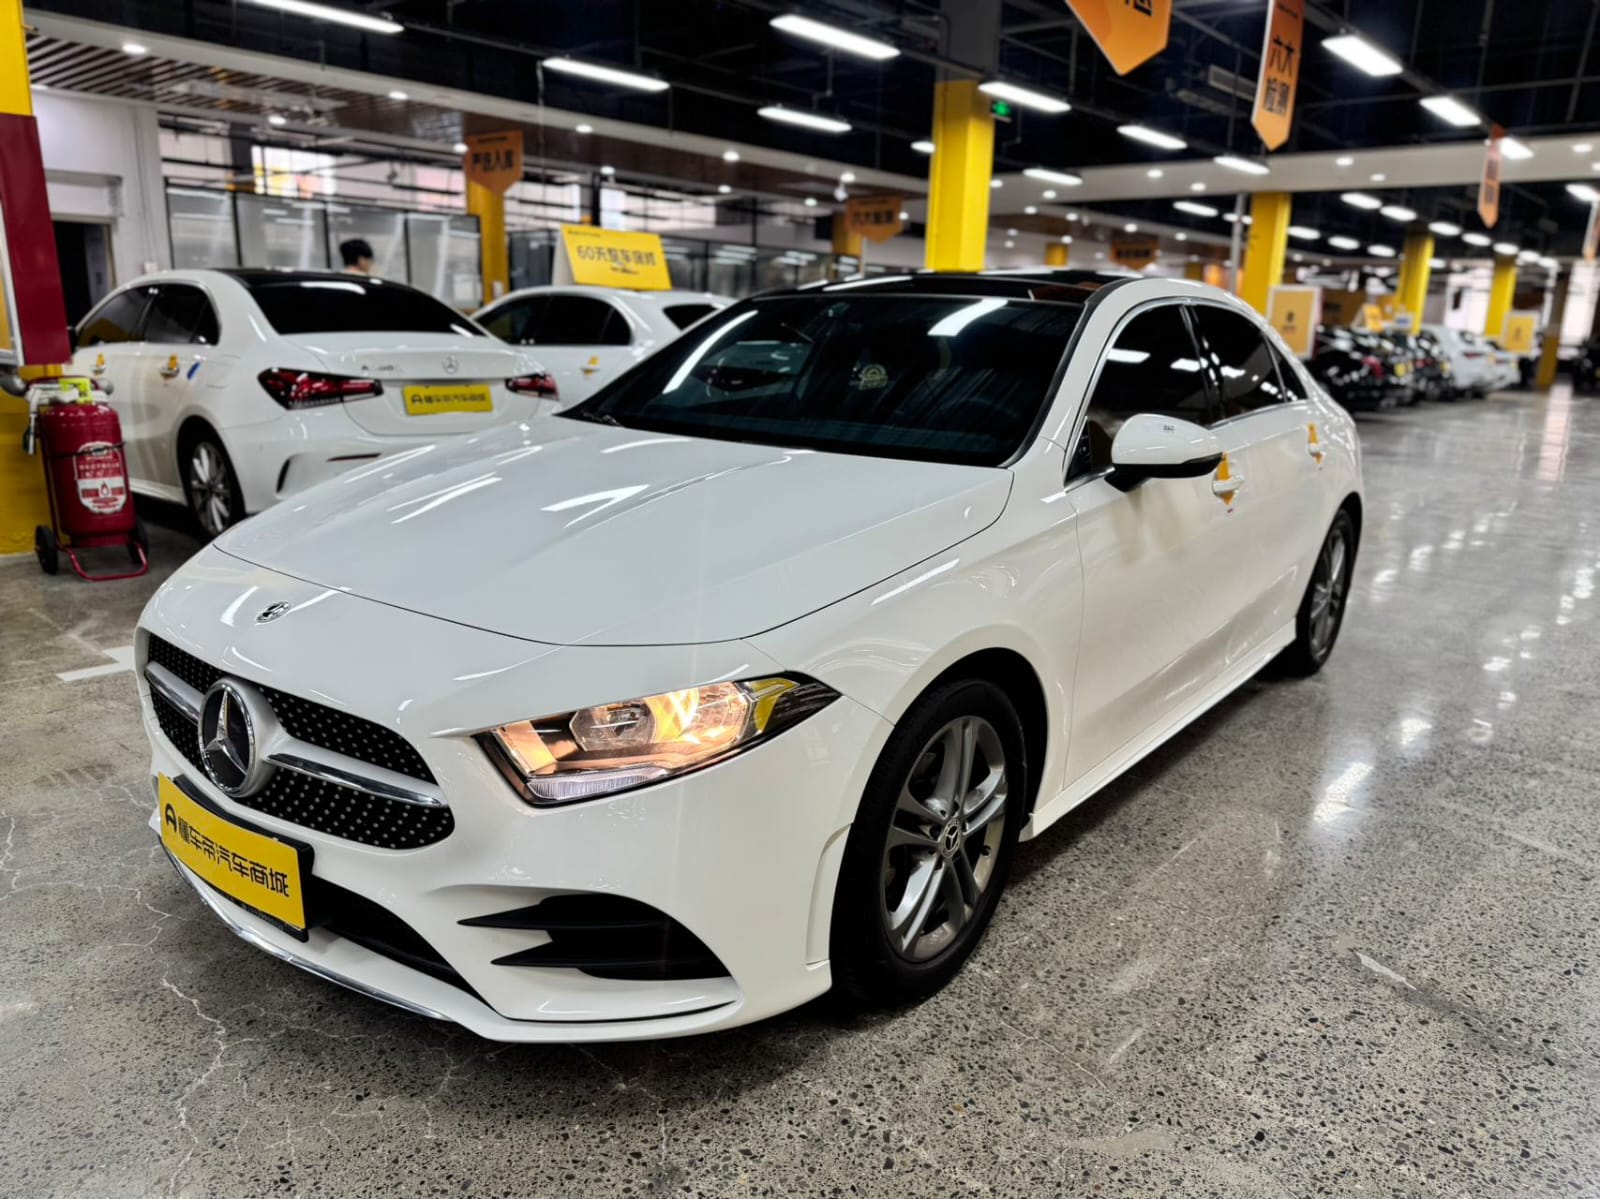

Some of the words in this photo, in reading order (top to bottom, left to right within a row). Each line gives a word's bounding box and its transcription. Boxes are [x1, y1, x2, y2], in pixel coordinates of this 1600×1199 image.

[1270, 36, 1295, 77] 六大
[178, 816, 290, 898] 懂车帝汽车商城
